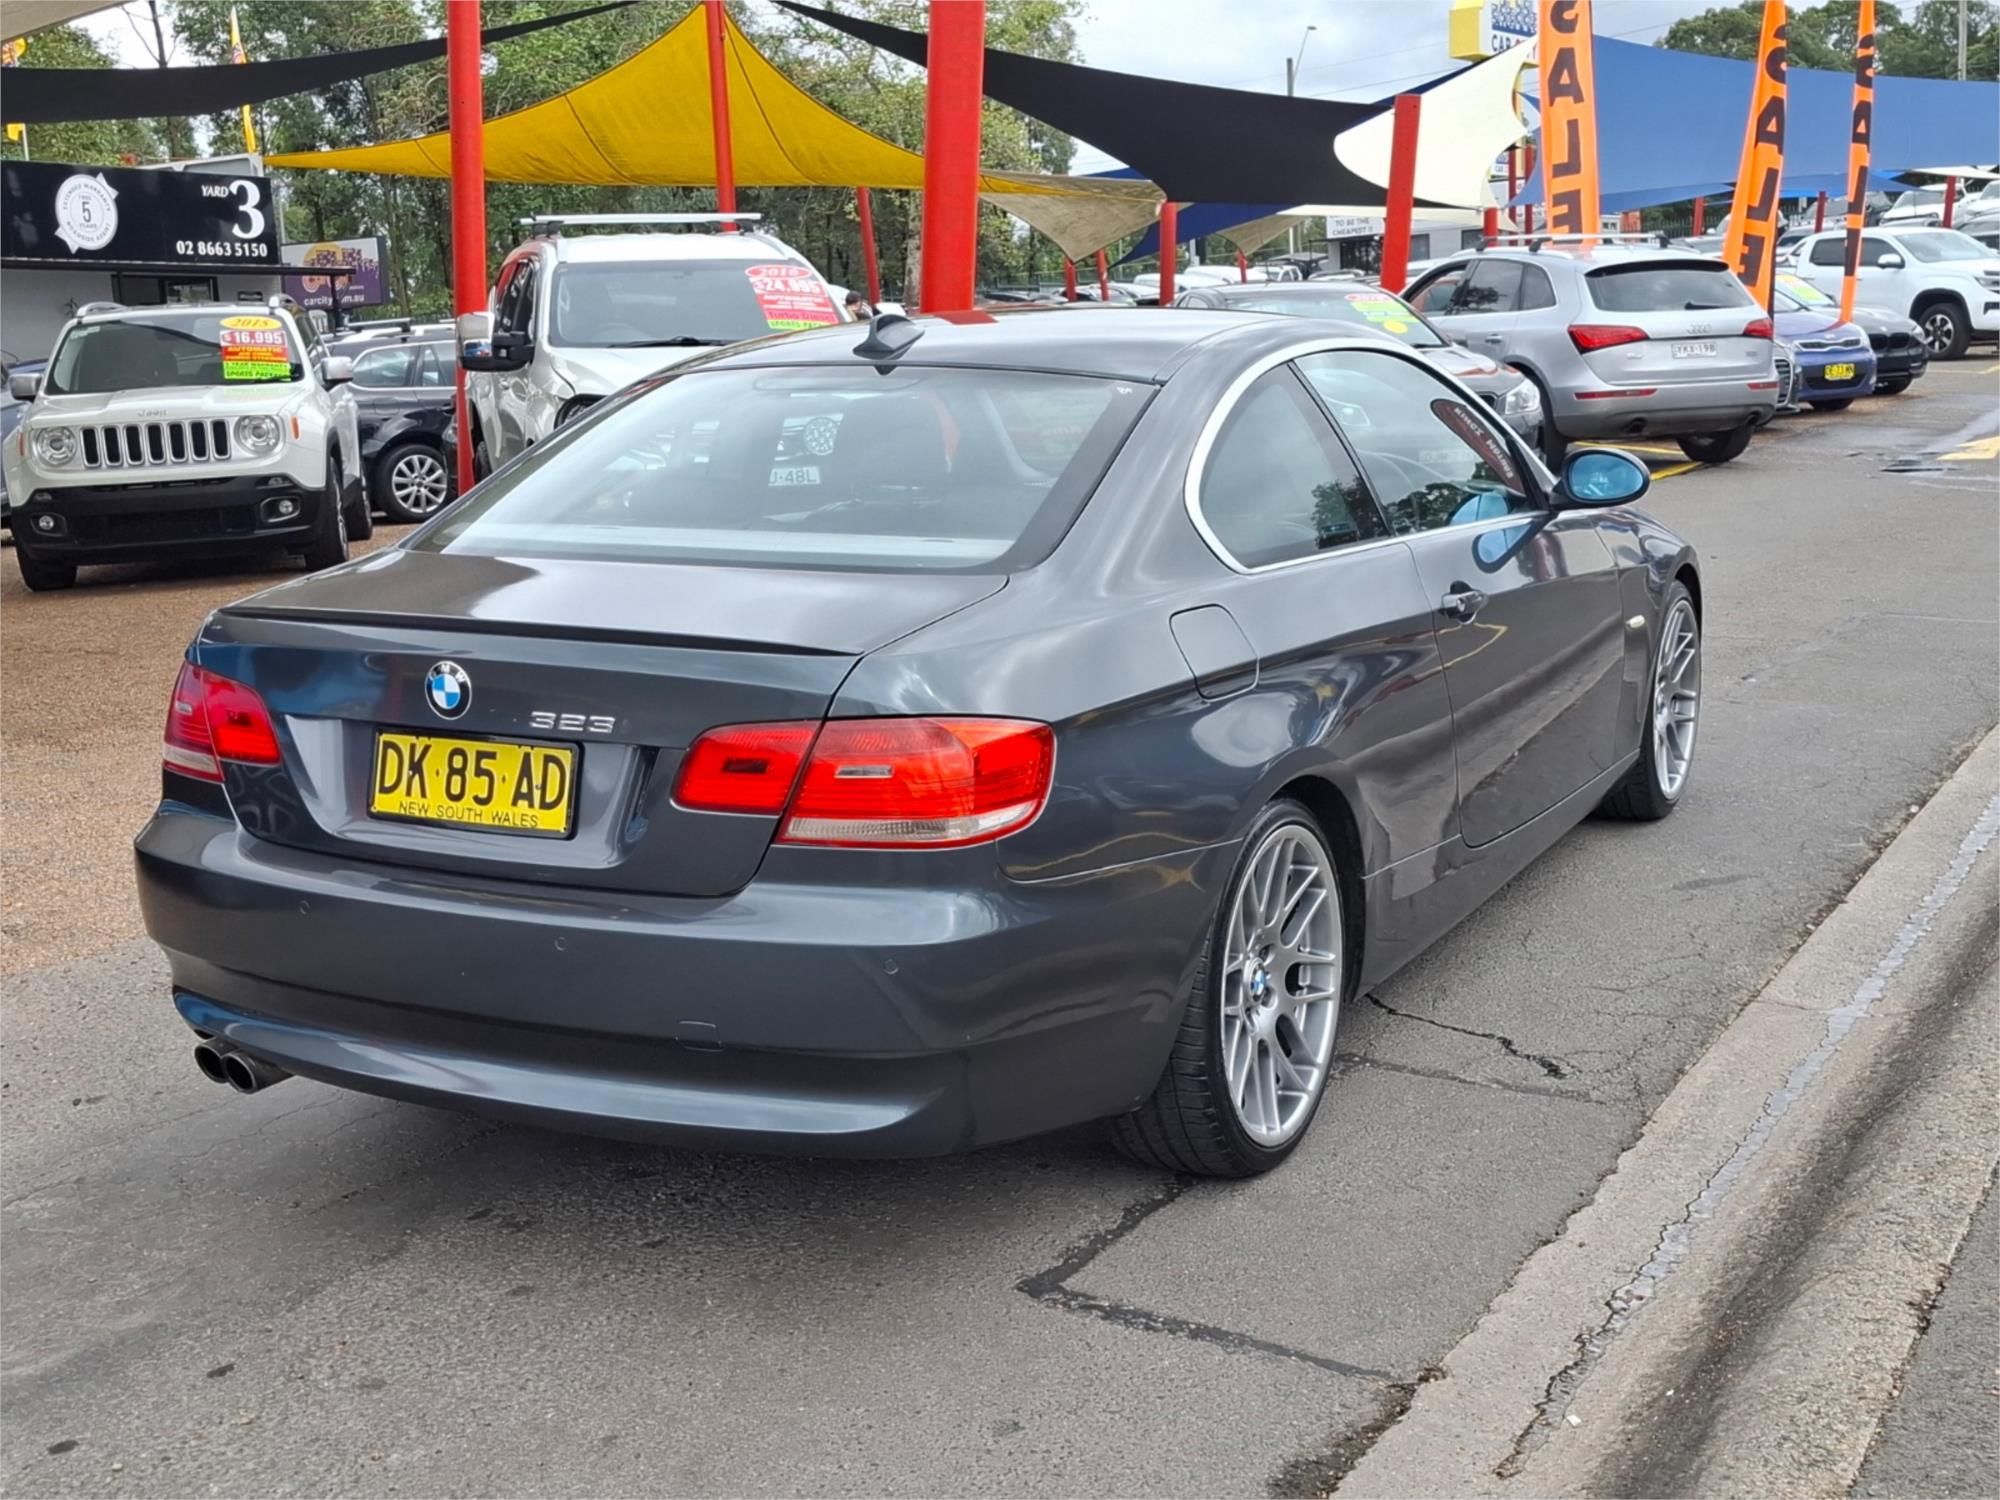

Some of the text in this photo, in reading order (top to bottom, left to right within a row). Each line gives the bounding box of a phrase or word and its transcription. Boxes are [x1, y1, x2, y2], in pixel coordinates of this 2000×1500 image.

[82, 201, 92, 223] 5
[201, 179, 265, 239] YARD 3
[176, 240, 268, 257] 02 8663 5150
[760, 266, 799, 277] 2016
[230, 318, 269, 328] 2015
[223, 331, 282, 344] $16,995
[529, 711, 616, 733] 323
[399, 801, 539, 828] NEW SOUTH WALES
